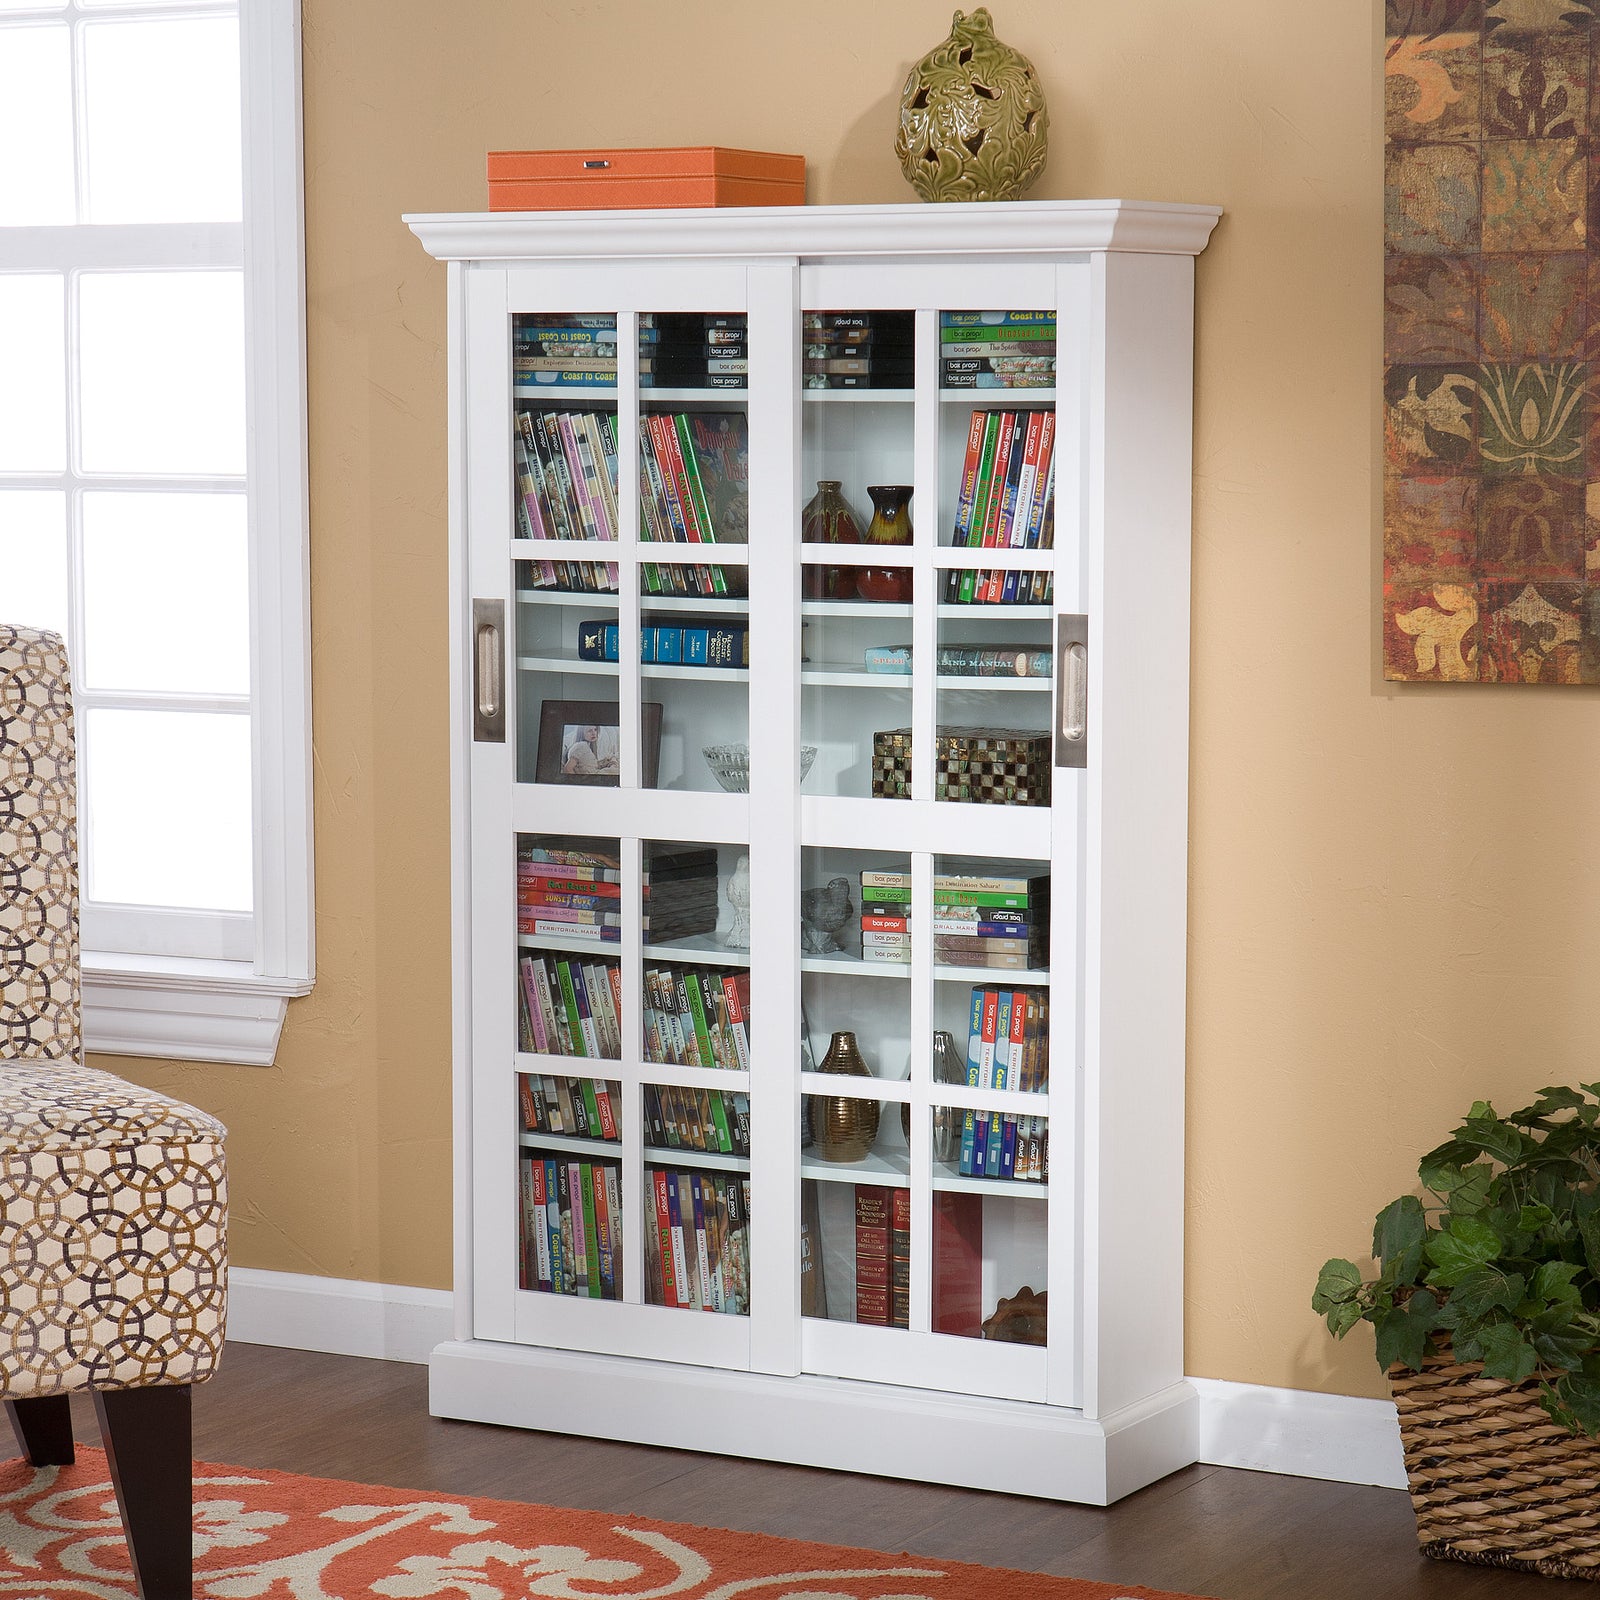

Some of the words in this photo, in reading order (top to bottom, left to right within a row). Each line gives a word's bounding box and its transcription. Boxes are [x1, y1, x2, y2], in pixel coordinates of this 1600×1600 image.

[1010, 311, 1033, 321] Coast
[1035, 311, 1044, 320] to
[538, 333, 559, 342] Coast
[571, 333, 592, 342] Coast
[1040, 327, 1055, 337] Daz
[562, 372, 584, 381] Coast
[586, 372, 593, 381] to
[595, 372, 616, 382] Coast
[964, 470, 975, 501] SUNSET
[1035, 471, 1045, 503] SUNSET
[1019, 470, 1030, 518] TERRITORIAL
[969, 660, 1014, 669] MANUAL
[874, 874, 886, 882] box
[589, 883, 597, 893] 9
[544, 894, 571, 904] SUNSET
[872, 919, 884, 927] box
[539, 924, 579, 935] TERRITORIAL
[988, 1004, 996, 1017] box
[736, 1027, 749, 1070] TERRITORIA
[1010, 1048, 1018, 1090] TERRITORIA
[965, 1111, 974, 1131] oast
[992, 1113, 1000, 1133] oast
[600, 1222, 610, 1253] SUNSET
[552, 1234, 560, 1257] Coast
